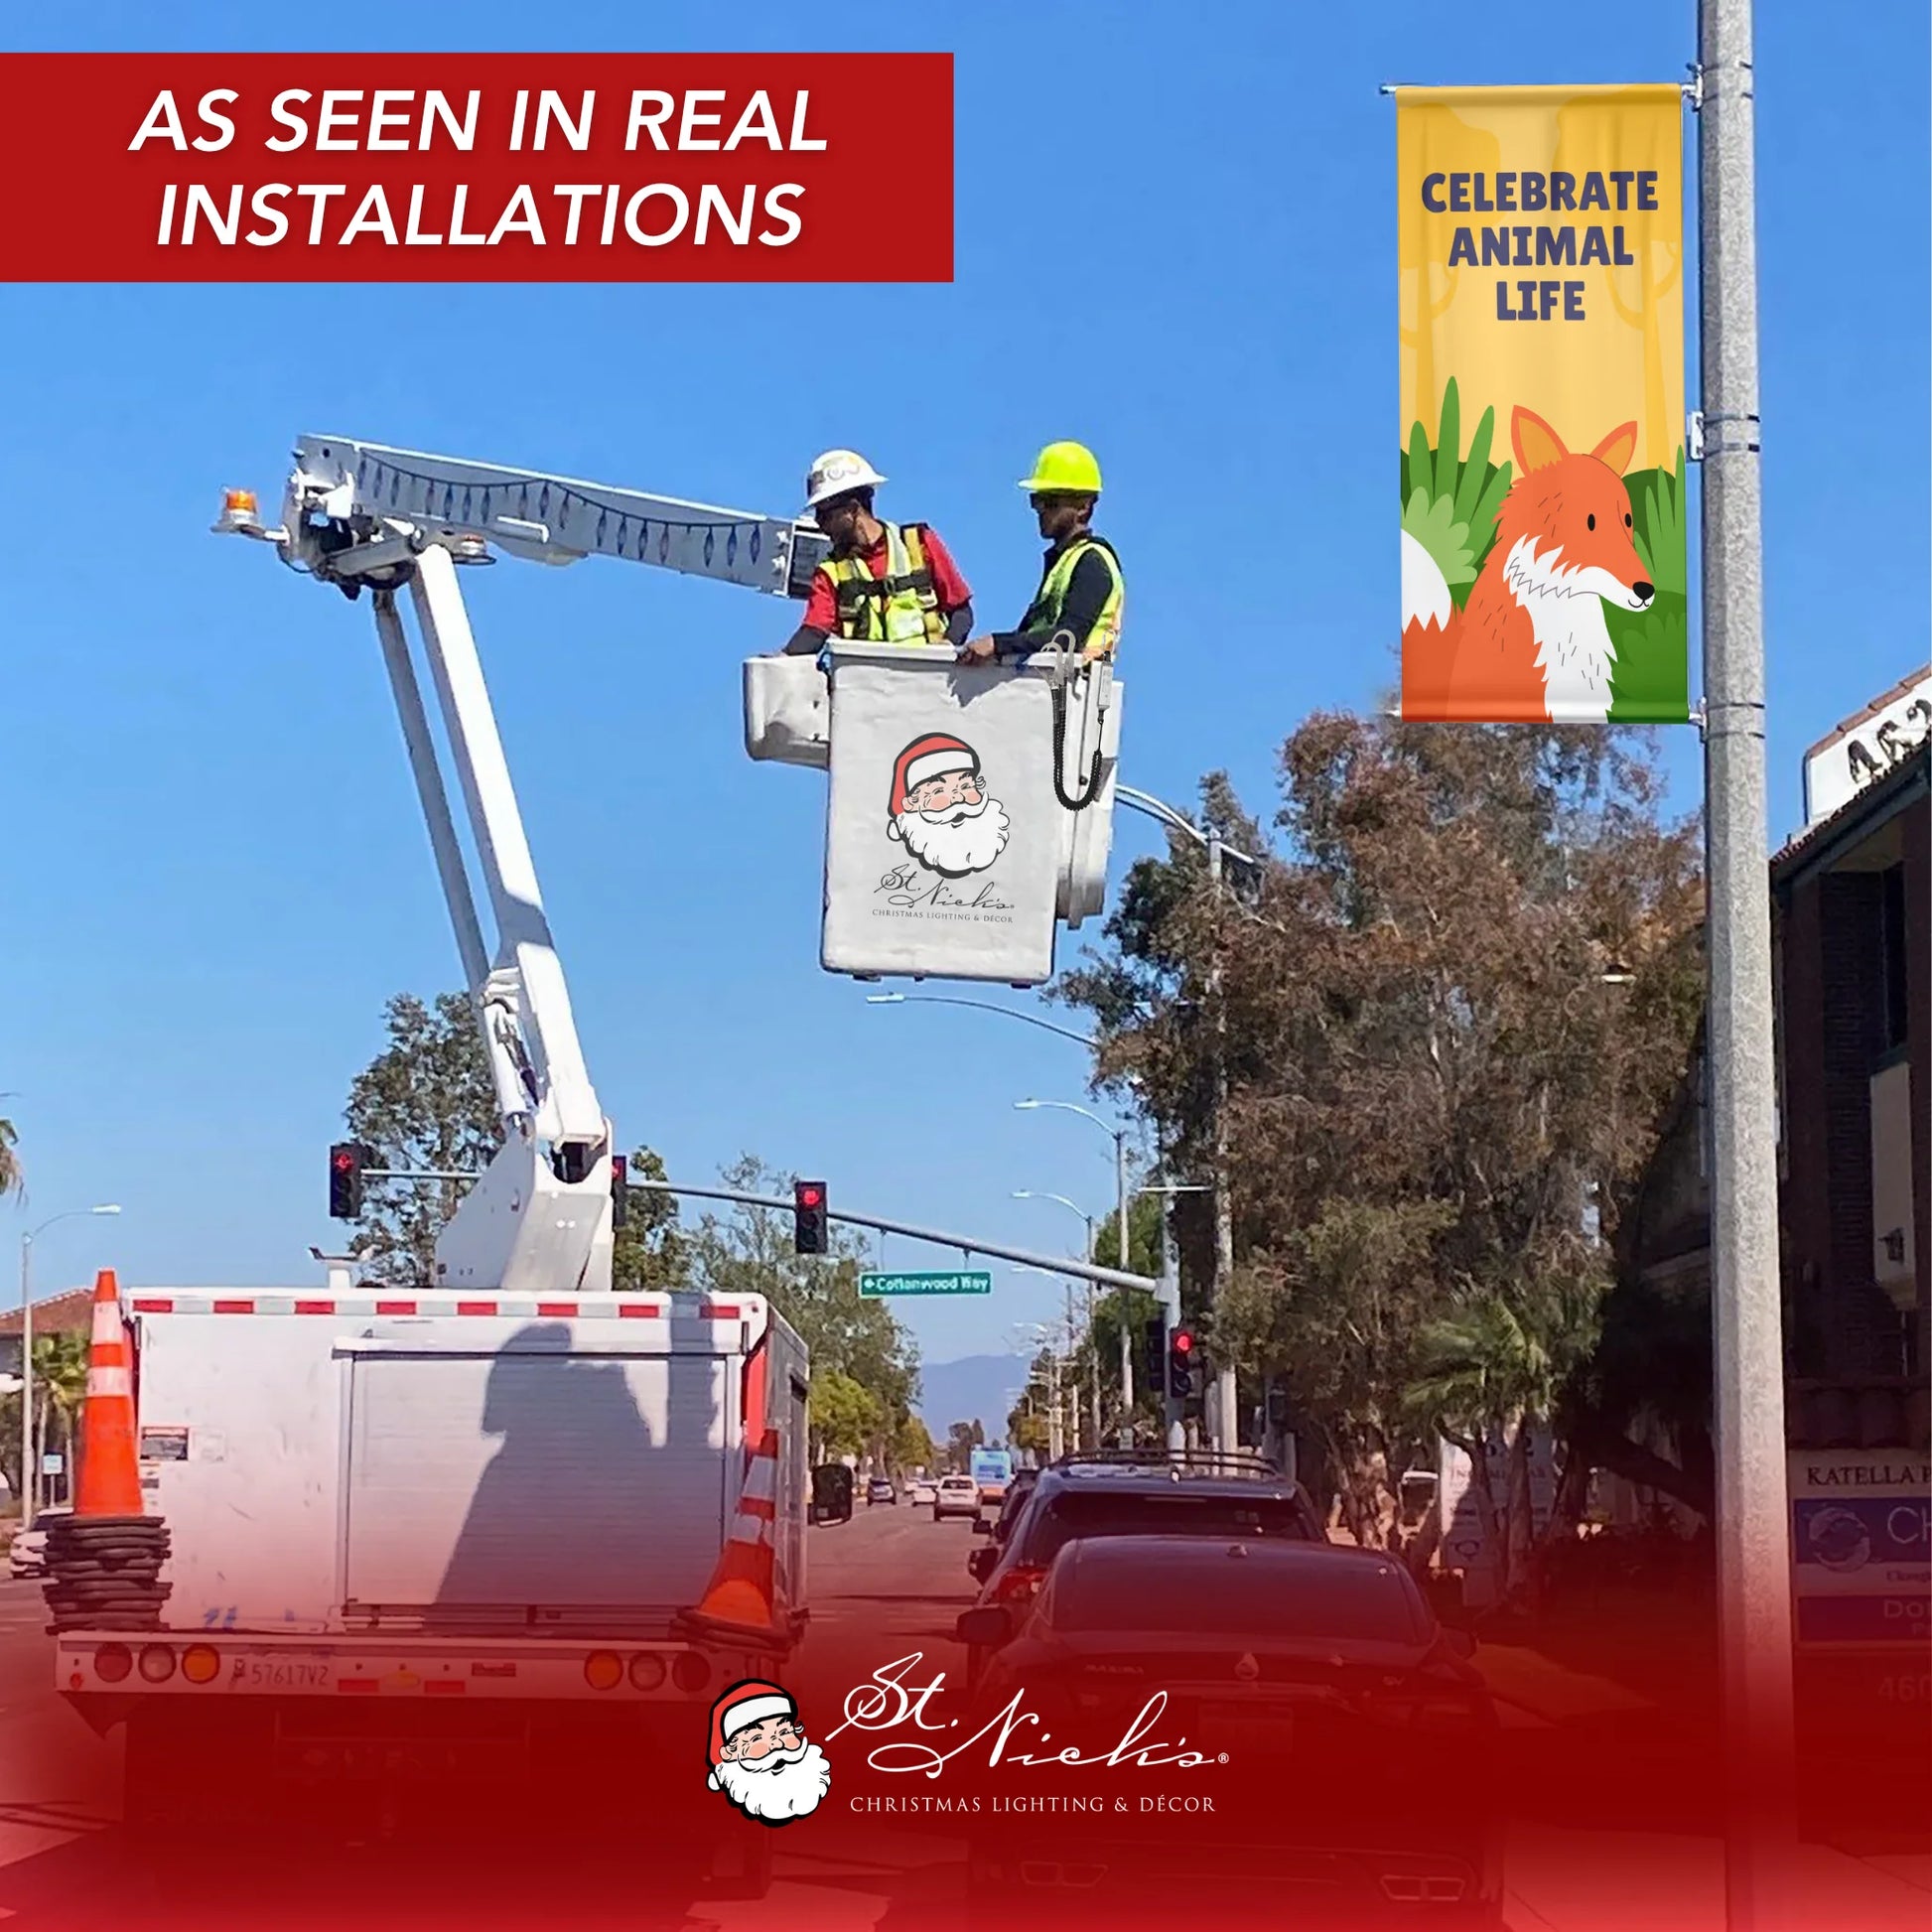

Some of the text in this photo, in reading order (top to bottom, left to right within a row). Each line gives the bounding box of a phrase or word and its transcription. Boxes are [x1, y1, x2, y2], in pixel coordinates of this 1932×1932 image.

[1422, 171, 1659, 212] CELEBRATE
[1449, 226, 1634, 267] ANIMAL
[1496, 281, 1586, 321] LIFE
[874, 863, 921, 894] St.
[872, 908, 923, 918] CHRISTMAS
[926, 911, 971, 921] LIGHTING
[983, 912, 1014, 923] DÉCOR
[1806, 1465, 1914, 1486] KATELLA
[251, 1663, 329, 1686] 57617V2
